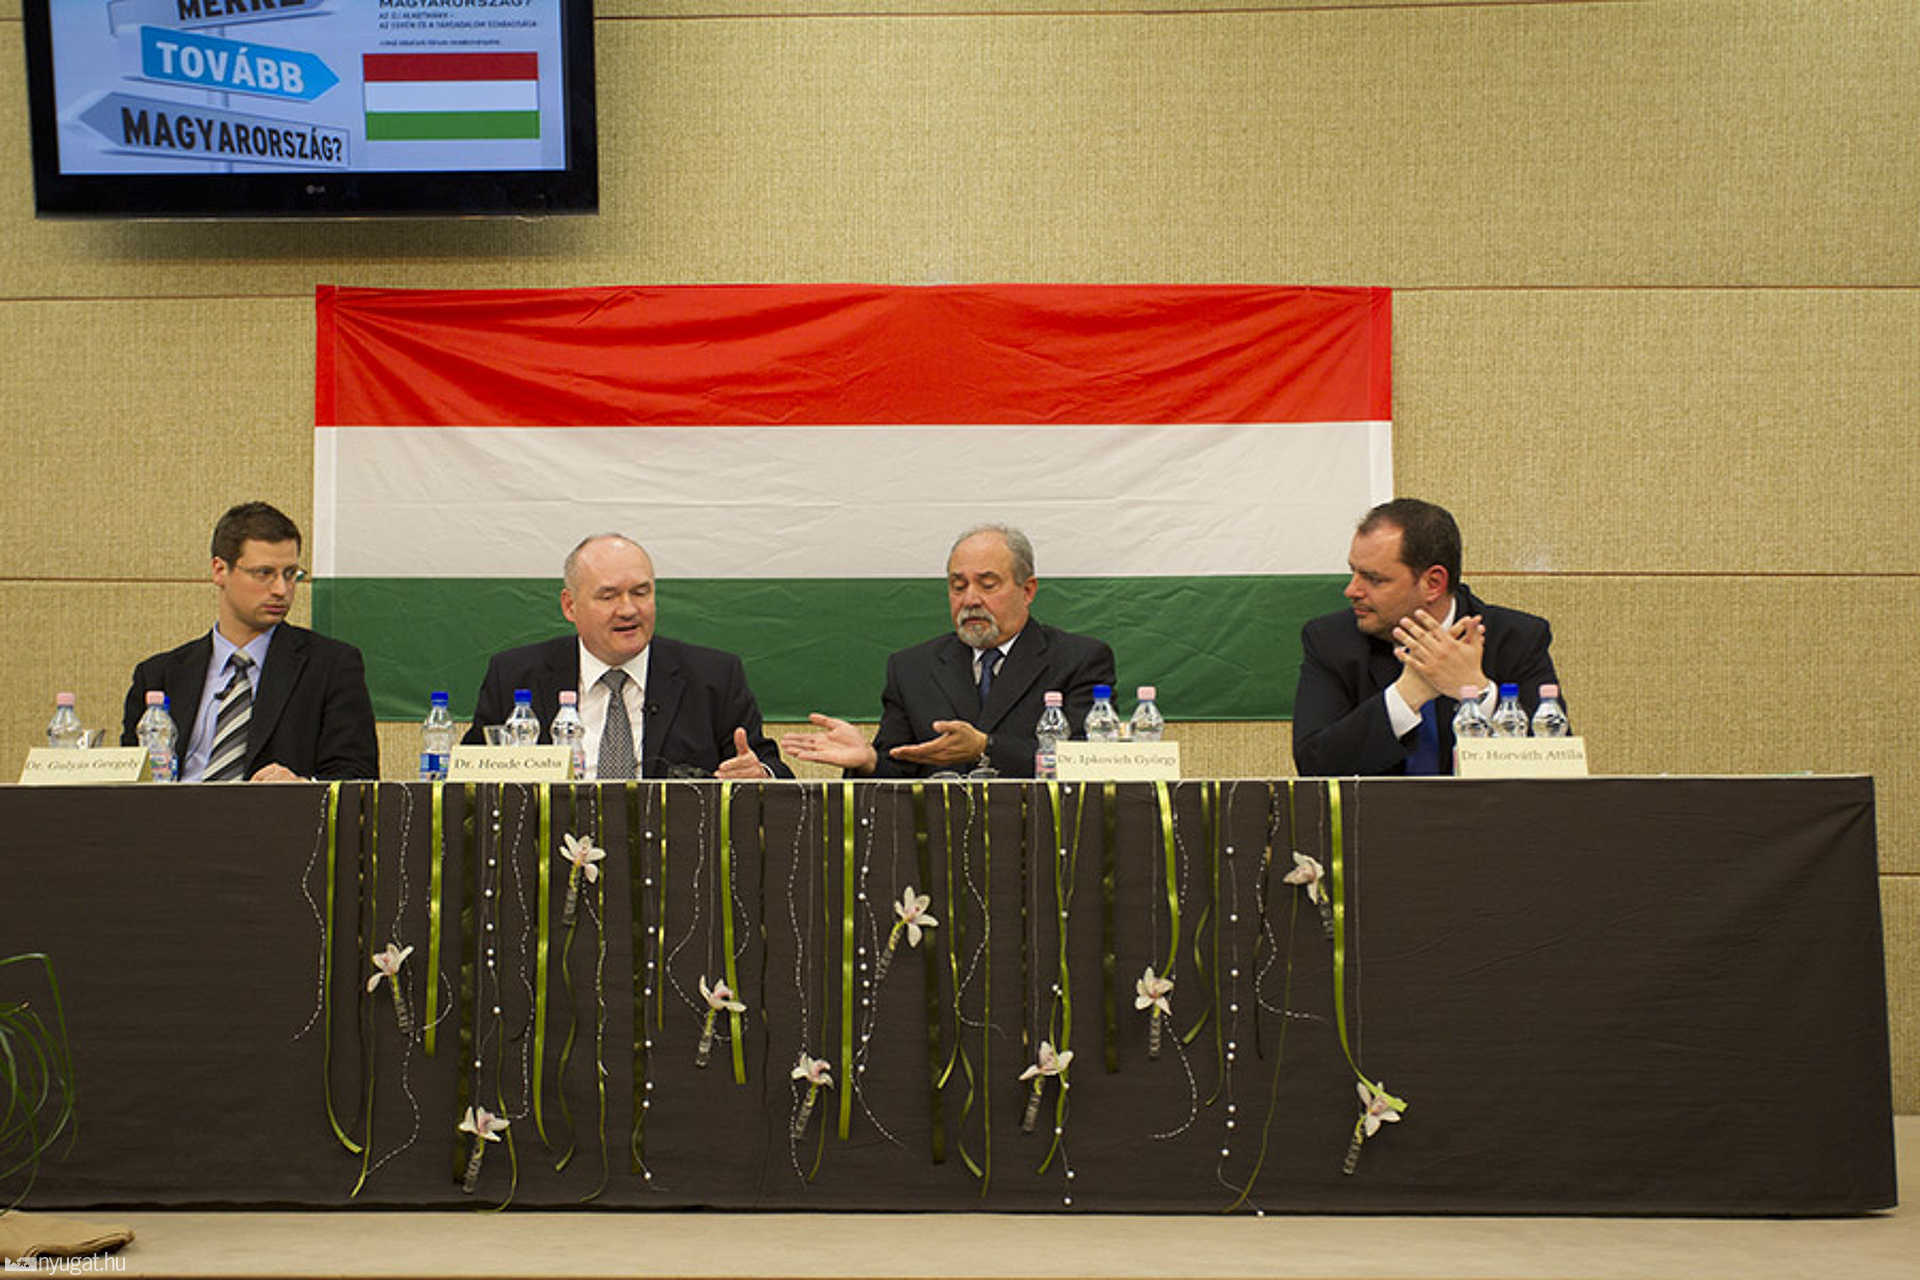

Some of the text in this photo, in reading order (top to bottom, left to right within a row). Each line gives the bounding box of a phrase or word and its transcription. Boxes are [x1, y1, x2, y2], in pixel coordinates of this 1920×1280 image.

[177, 0, 304, 20] MER
[156, 42, 304, 94] TOVÁBB
[121, 106, 342, 163] MAGYARORSZÁG?
[454, 758, 475, 769] Dr.
[1462, 750, 1484, 761] Dr.
